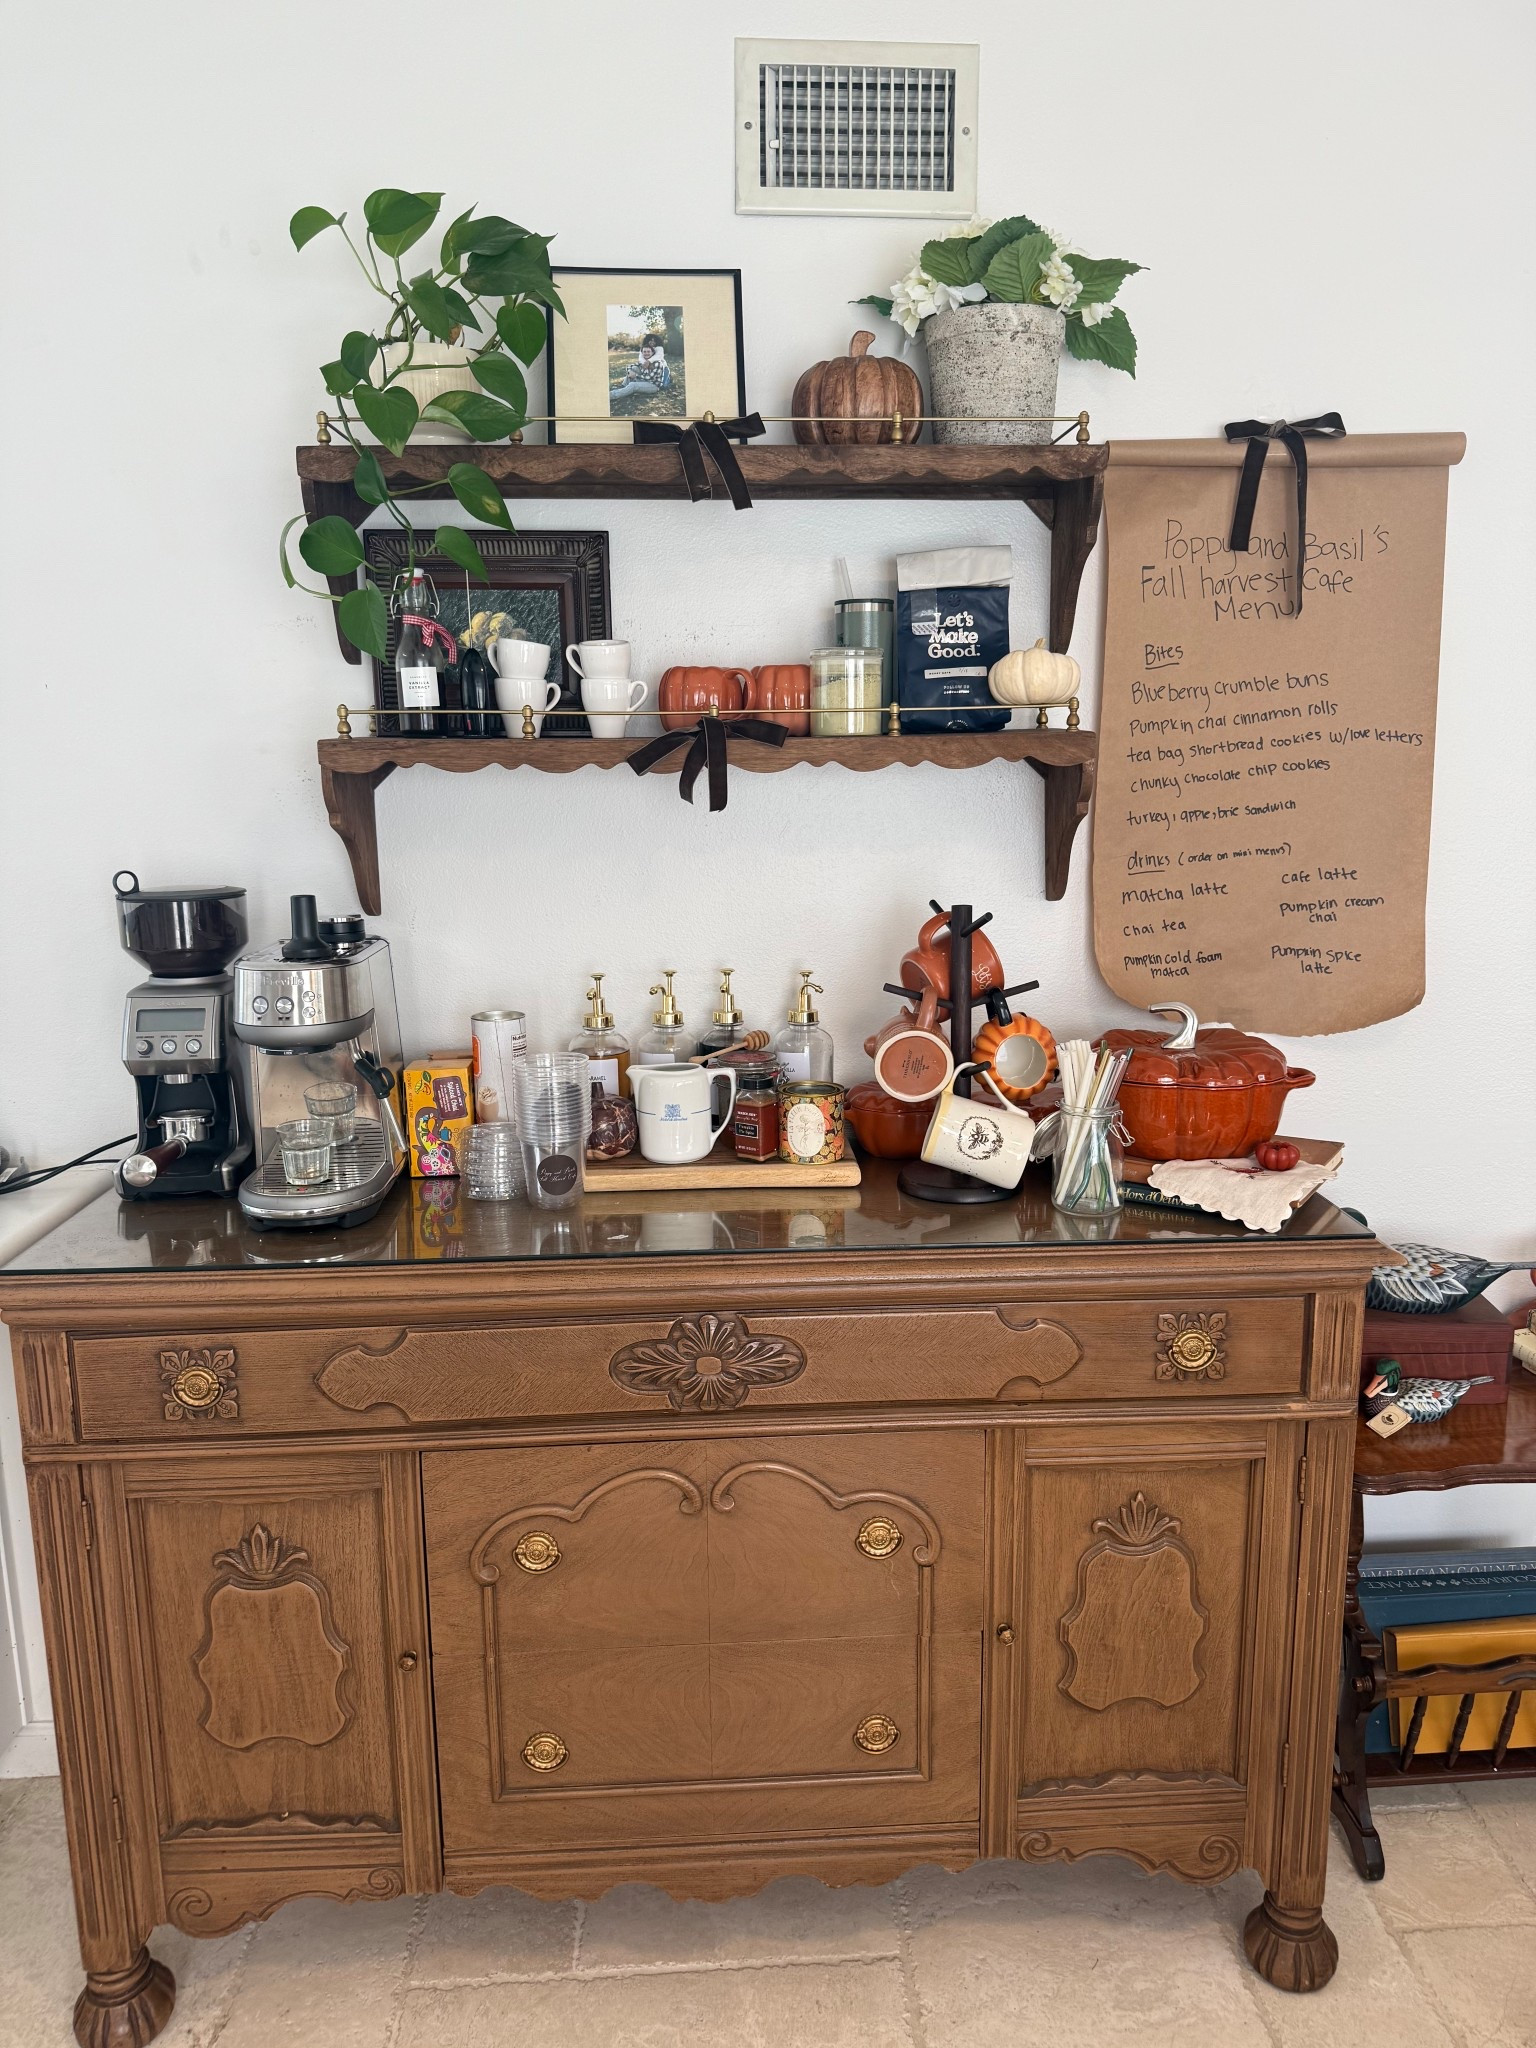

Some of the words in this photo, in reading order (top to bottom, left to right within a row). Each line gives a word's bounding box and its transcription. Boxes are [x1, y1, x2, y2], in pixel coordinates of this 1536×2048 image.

[1165, 519, 1237, 575] Poppy
[1247, 532, 1289, 559] and
[1304, 525, 1390, 563] Basil's
[1141, 566, 1187, 602] Fall
[1200, 566, 1294, 599] harvest
[1302, 568, 1353, 593] Cafe
[934, 611, 974, 627] Let's
[1214, 596, 1295, 621] Menu
[928, 628, 979, 644] Make
[1144, 643, 1183, 667] Bites
[1131, 681, 1211, 713] Blueberry
[1214, 676, 1281, 695] crumble
[1286, 672, 1329, 689] buns
[1197, 715, 1227, 730] chai
[1233, 706, 1302, 726] cinnamon
[1308, 700, 1338, 716] rolls
[1127, 746, 1151, 762] tea
[1158, 746, 1185, 767] bag
[1270, 730, 1322, 749] cookies
[1374, 728, 1424, 747] letters
[1131, 776, 1182, 798] chunky
[1184, 769, 1241, 784] chocolate
[1247, 763, 1277, 776] chip
[1282, 758, 1331, 772] cookies
[1127, 851, 1171, 871] drinks
[1217, 852, 1229, 861] on
[1232, 849, 1252, 858] mini
[1281, 870, 1311, 884] cafe
[1317, 867, 1358, 880] latte
[1122, 887, 1184, 905] matcha
[1190, 882, 1229, 896] latte
[1279, 899, 1338, 917] pumpkin
[1344, 896, 1385, 907] cream
[1308, 911, 1337, 923] chai
[1123, 923, 1155, 937] chai
[1161, 919, 1187, 932] tea
[1123, 953, 1162, 971] pumpkin
[1164, 949, 1192, 965] cold
[1195, 950, 1222, 964] foam
[1300, 960, 1333, 975] latte
[1150, 966, 1190, 979] matca
[447, 1081, 456, 1099] Spiced
[1117, 1187, 1144, 1202] Hors
[1363, 1581, 1421, 1589] FRANCE
